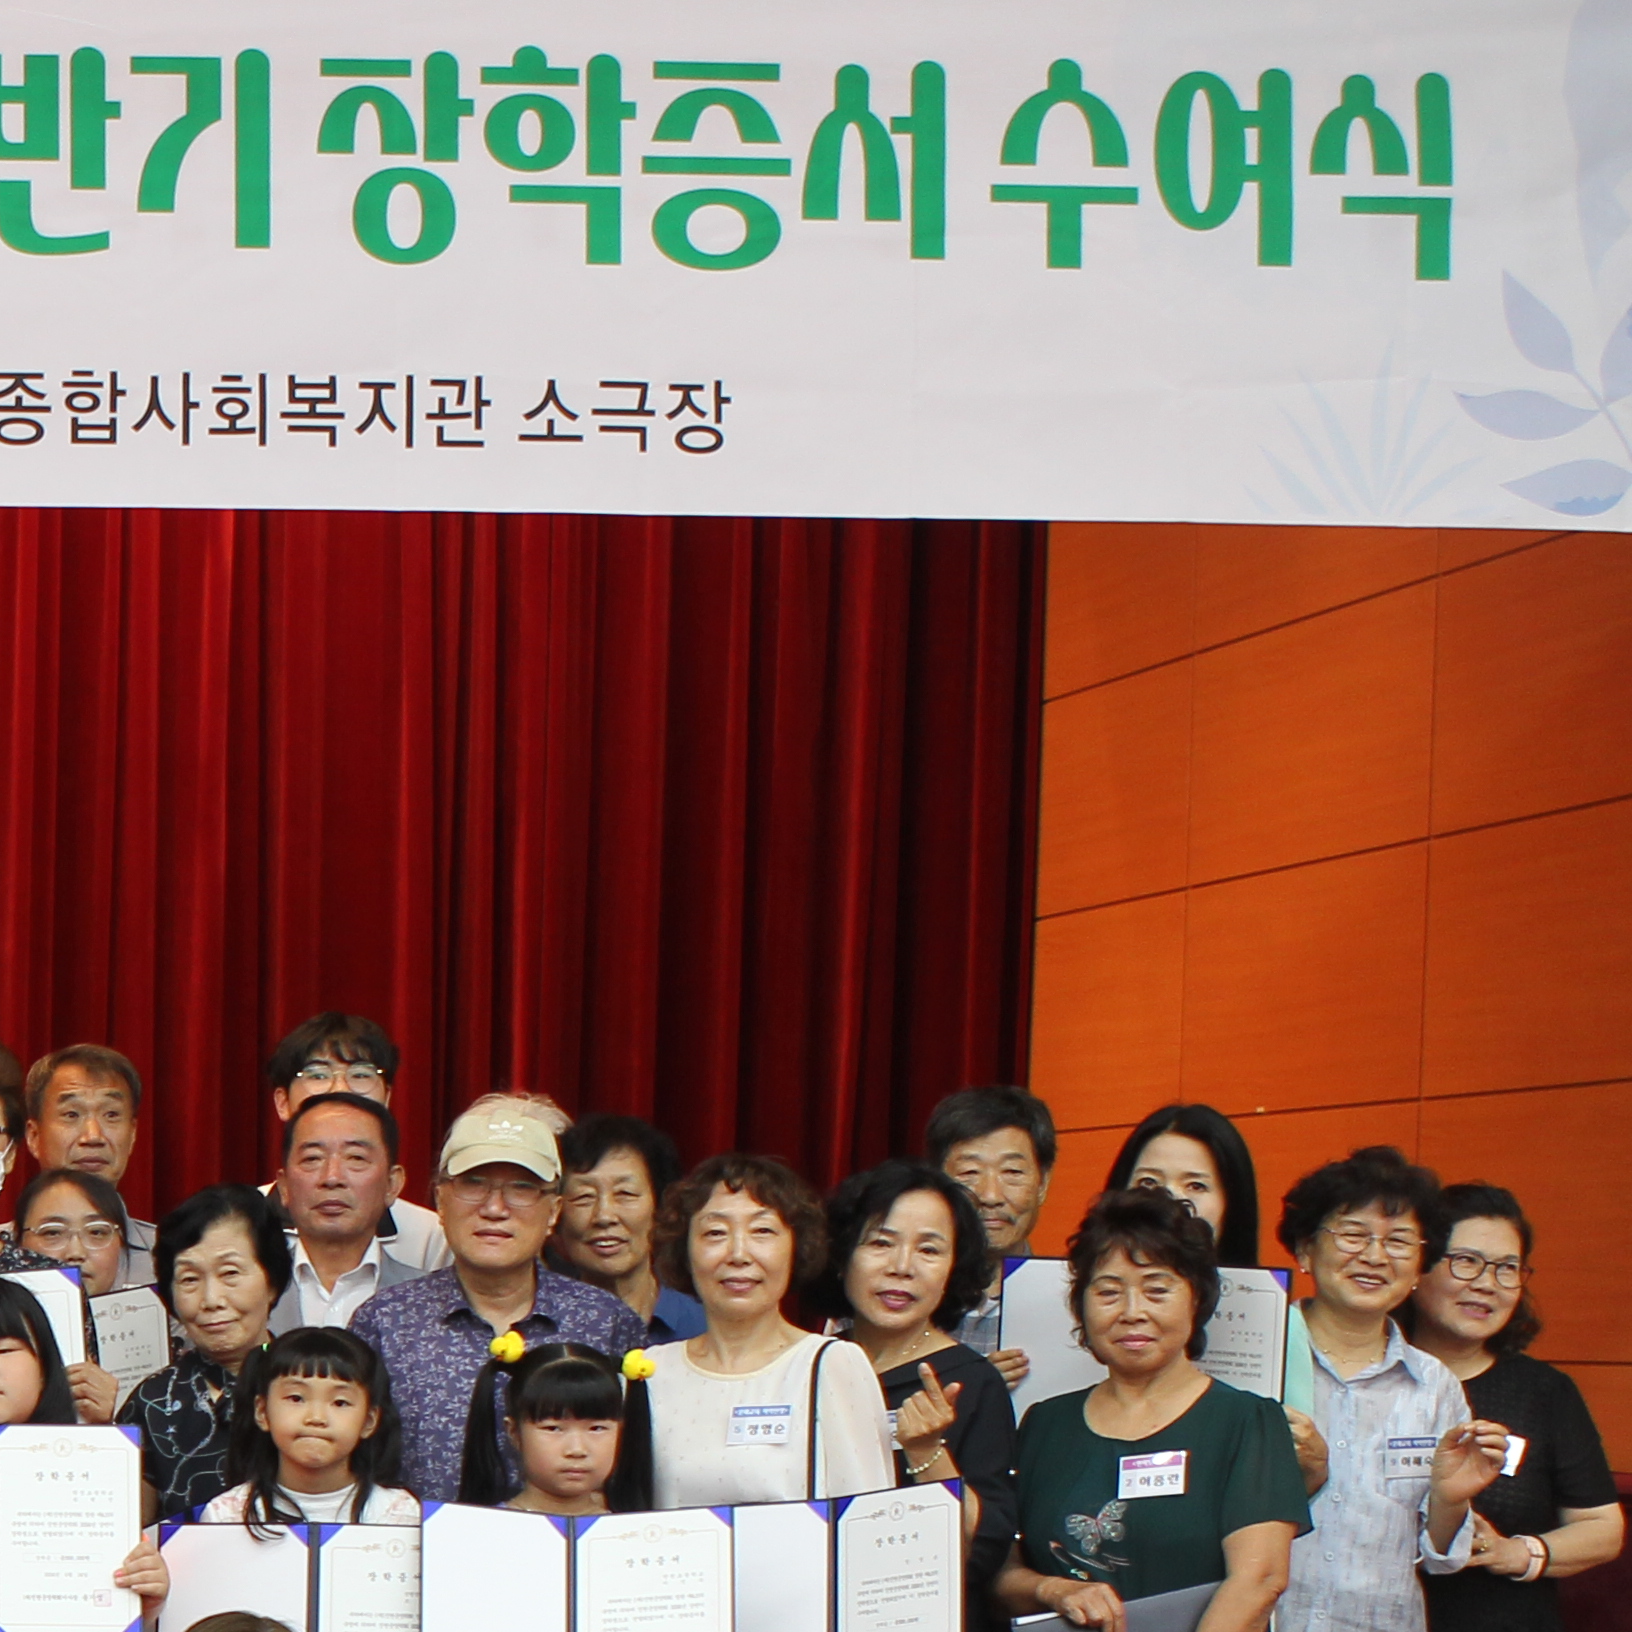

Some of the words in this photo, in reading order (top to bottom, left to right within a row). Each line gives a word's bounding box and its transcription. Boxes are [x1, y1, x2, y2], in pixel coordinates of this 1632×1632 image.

[316, 45, 948, 271] 장학증서
[989, 58, 1454, 281] 수여식
[517, 379, 733, 454] 소극장
